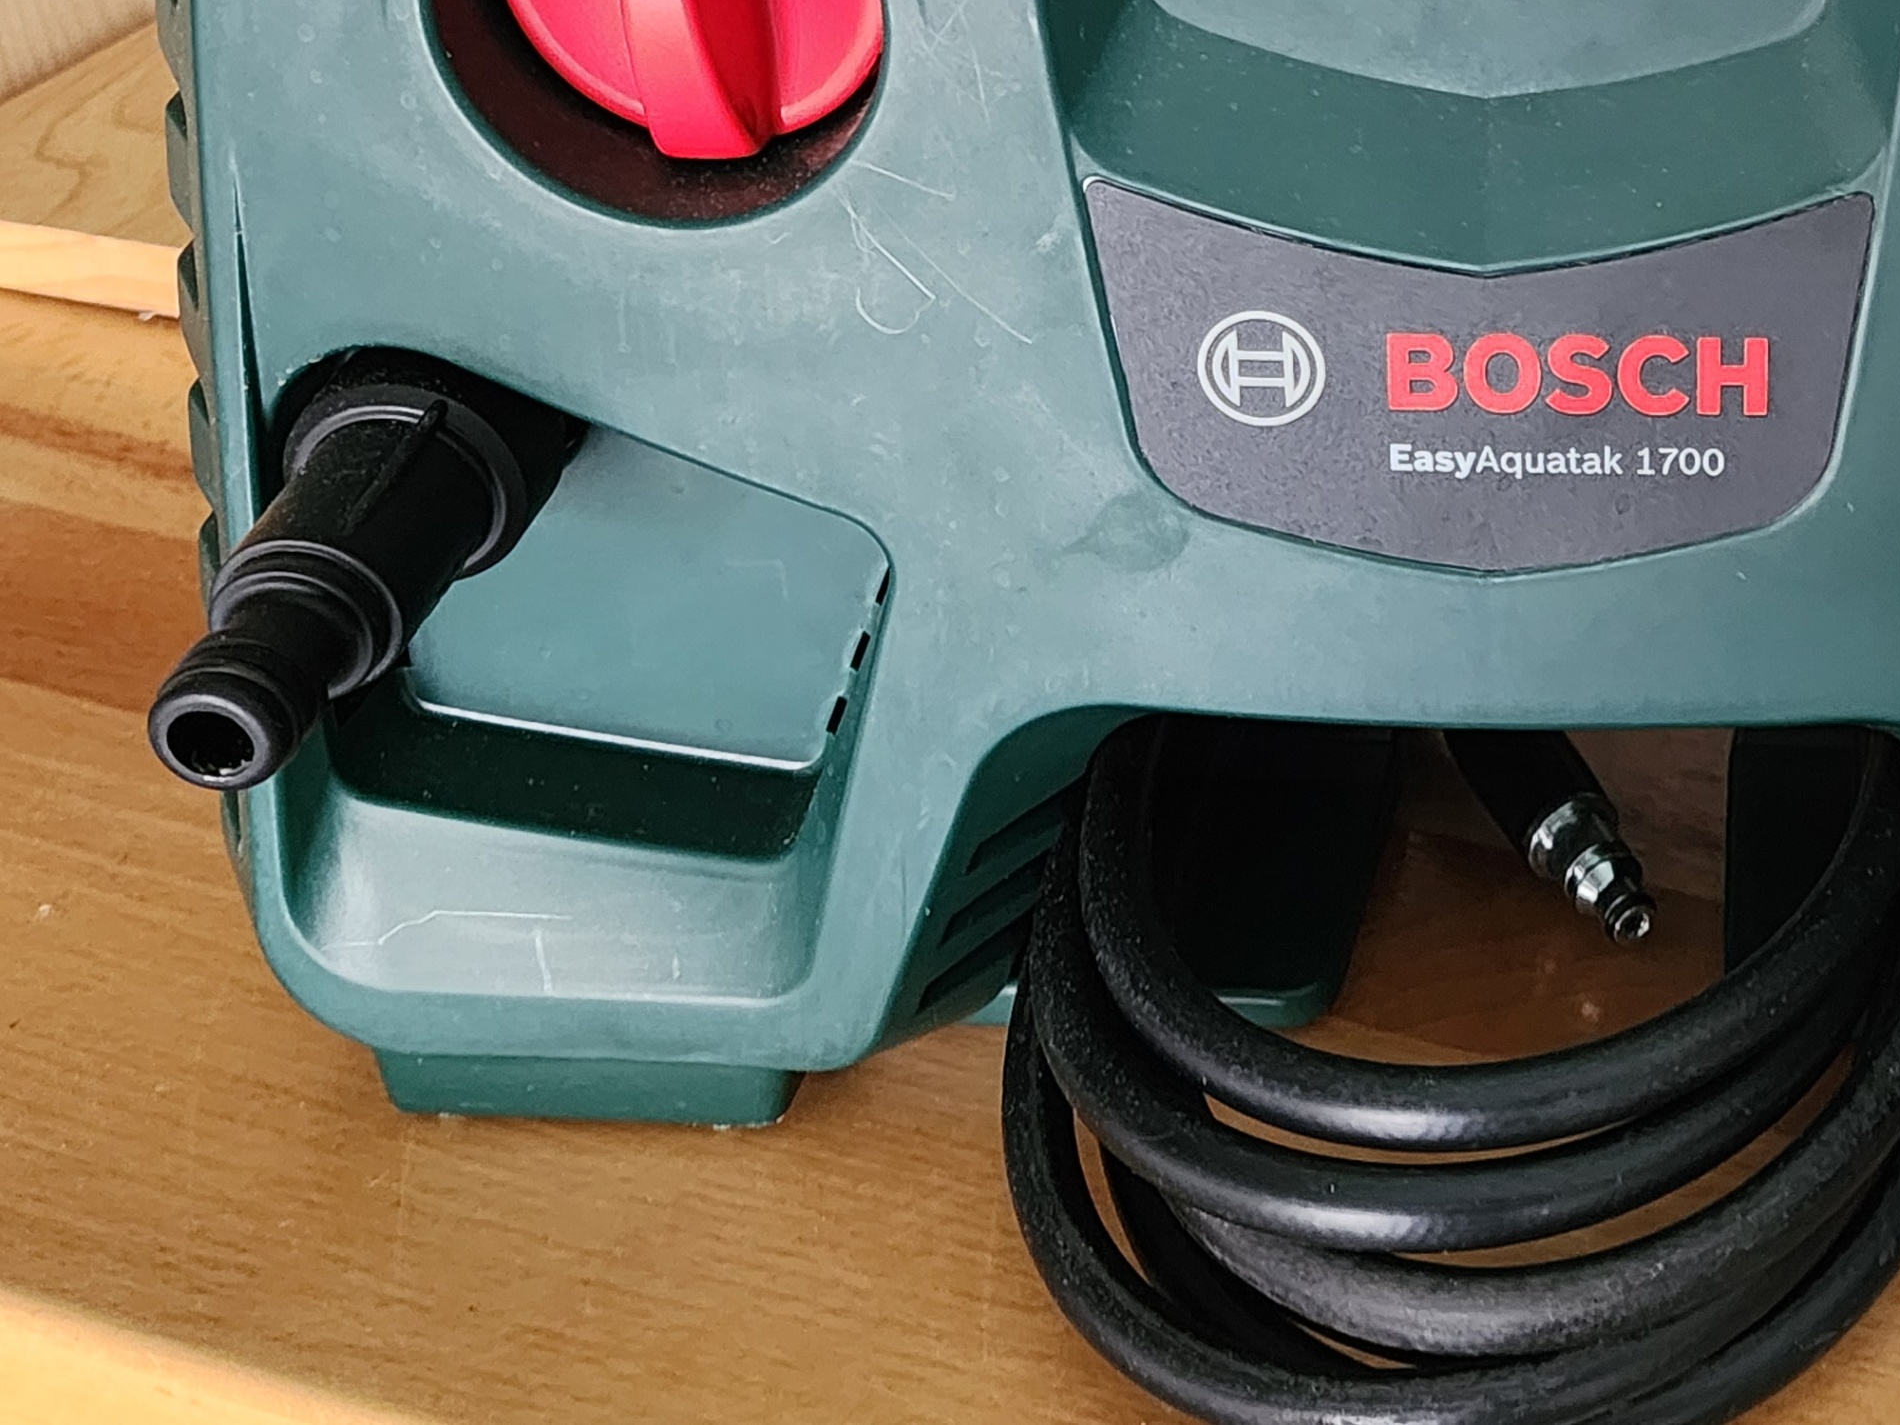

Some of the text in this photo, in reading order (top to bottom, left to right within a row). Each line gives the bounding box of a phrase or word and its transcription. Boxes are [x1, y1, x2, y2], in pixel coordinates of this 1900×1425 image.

[1385, 332, 1770, 417] BOSCH
[1388, 443, 1726, 480] EasyAquatak 1700
